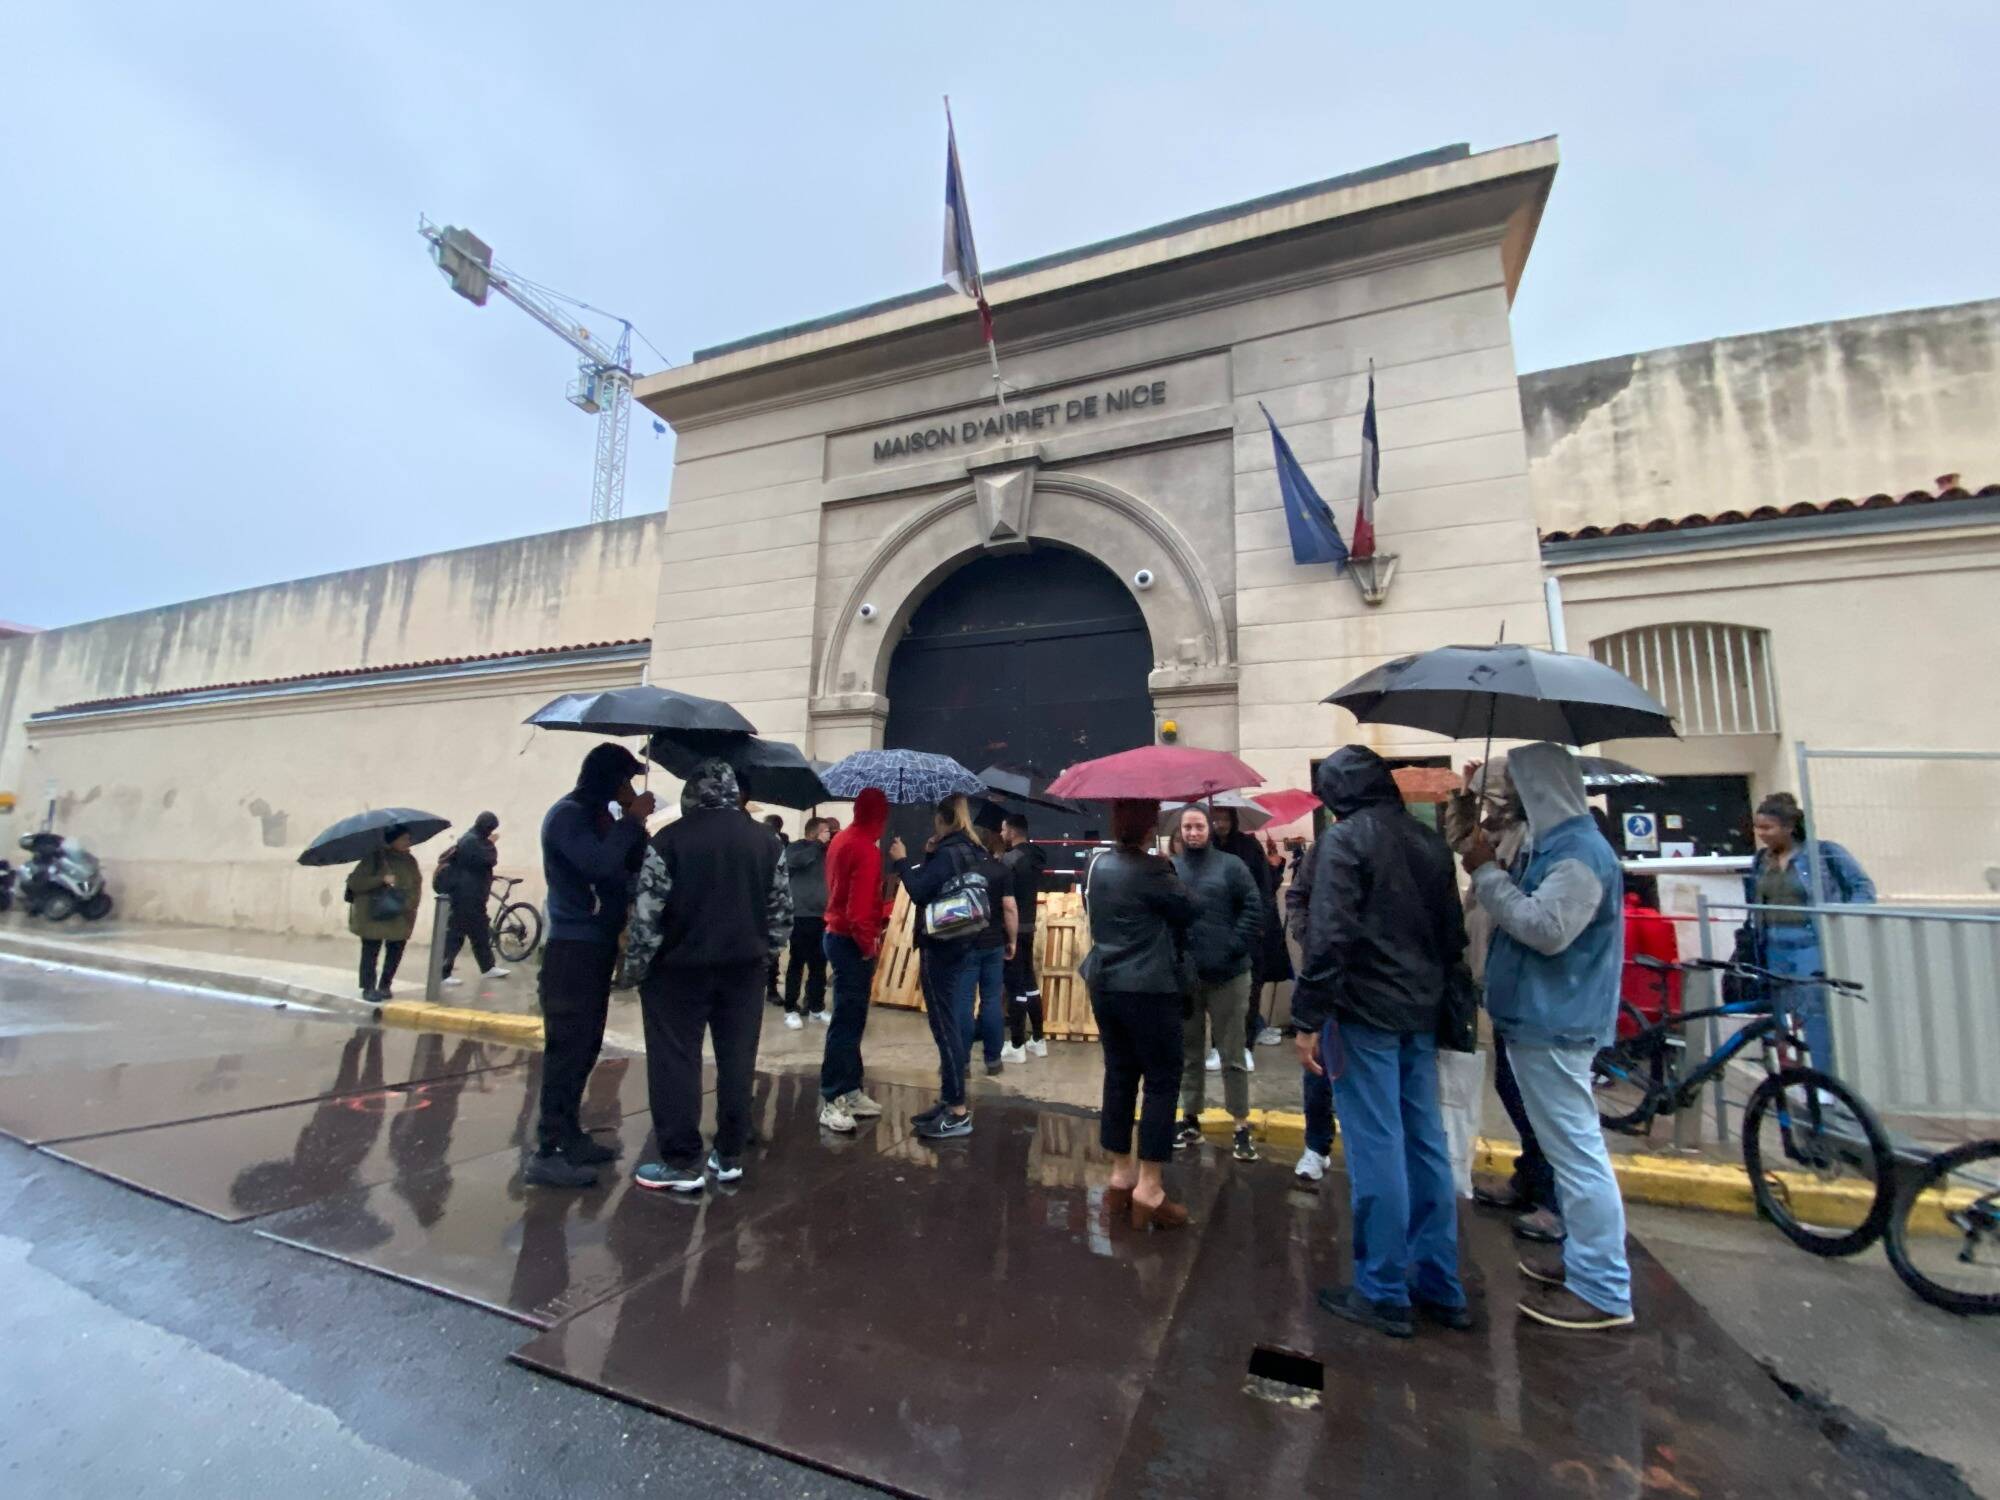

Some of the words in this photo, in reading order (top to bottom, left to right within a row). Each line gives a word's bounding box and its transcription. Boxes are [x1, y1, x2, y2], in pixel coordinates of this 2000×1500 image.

[874, 426, 955, 459] MAISON
[1066, 395, 1098, 423] DE
[1106, 381, 1166, 413] NICE
